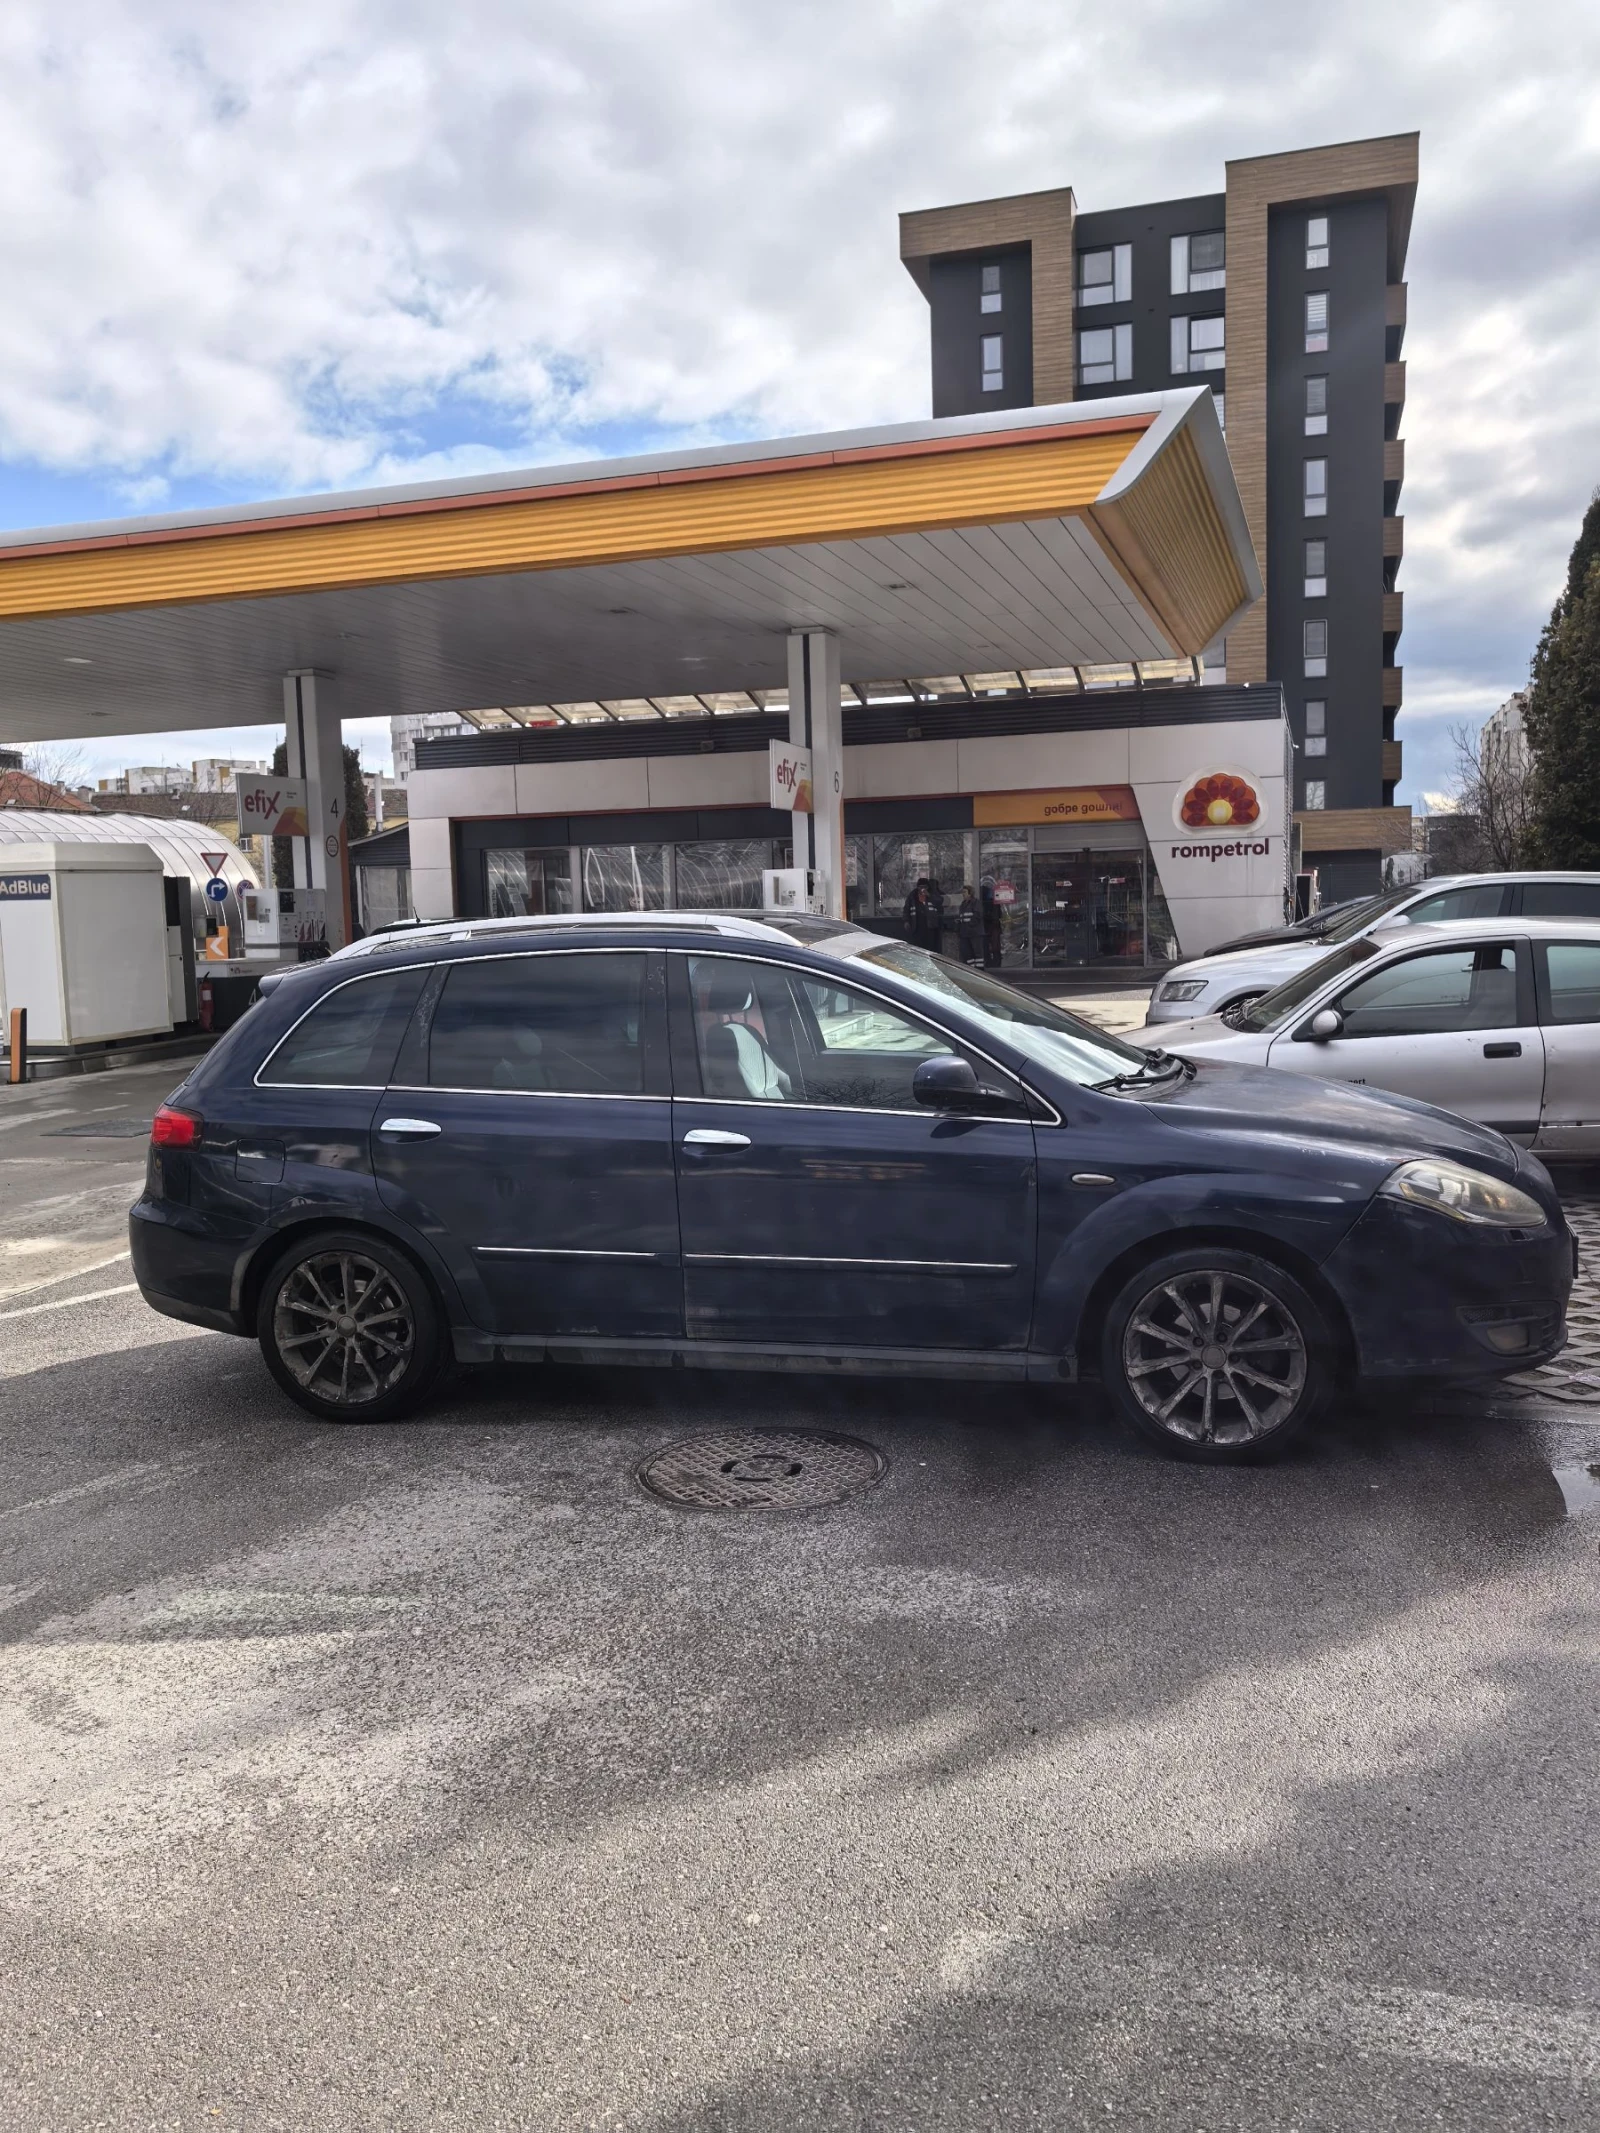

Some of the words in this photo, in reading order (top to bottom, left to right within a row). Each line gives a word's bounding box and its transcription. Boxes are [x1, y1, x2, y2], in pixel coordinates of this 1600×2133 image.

[777, 758, 798, 793] efix
[834, 771, 840, 793] 6
[244, 789, 281, 820] efix
[330, 798, 339, 818] 4
[1044, 803, 1079, 817] добре
[1171, 838, 1270, 862] rompetrol
[0, 880, 50, 895] AdBlue
